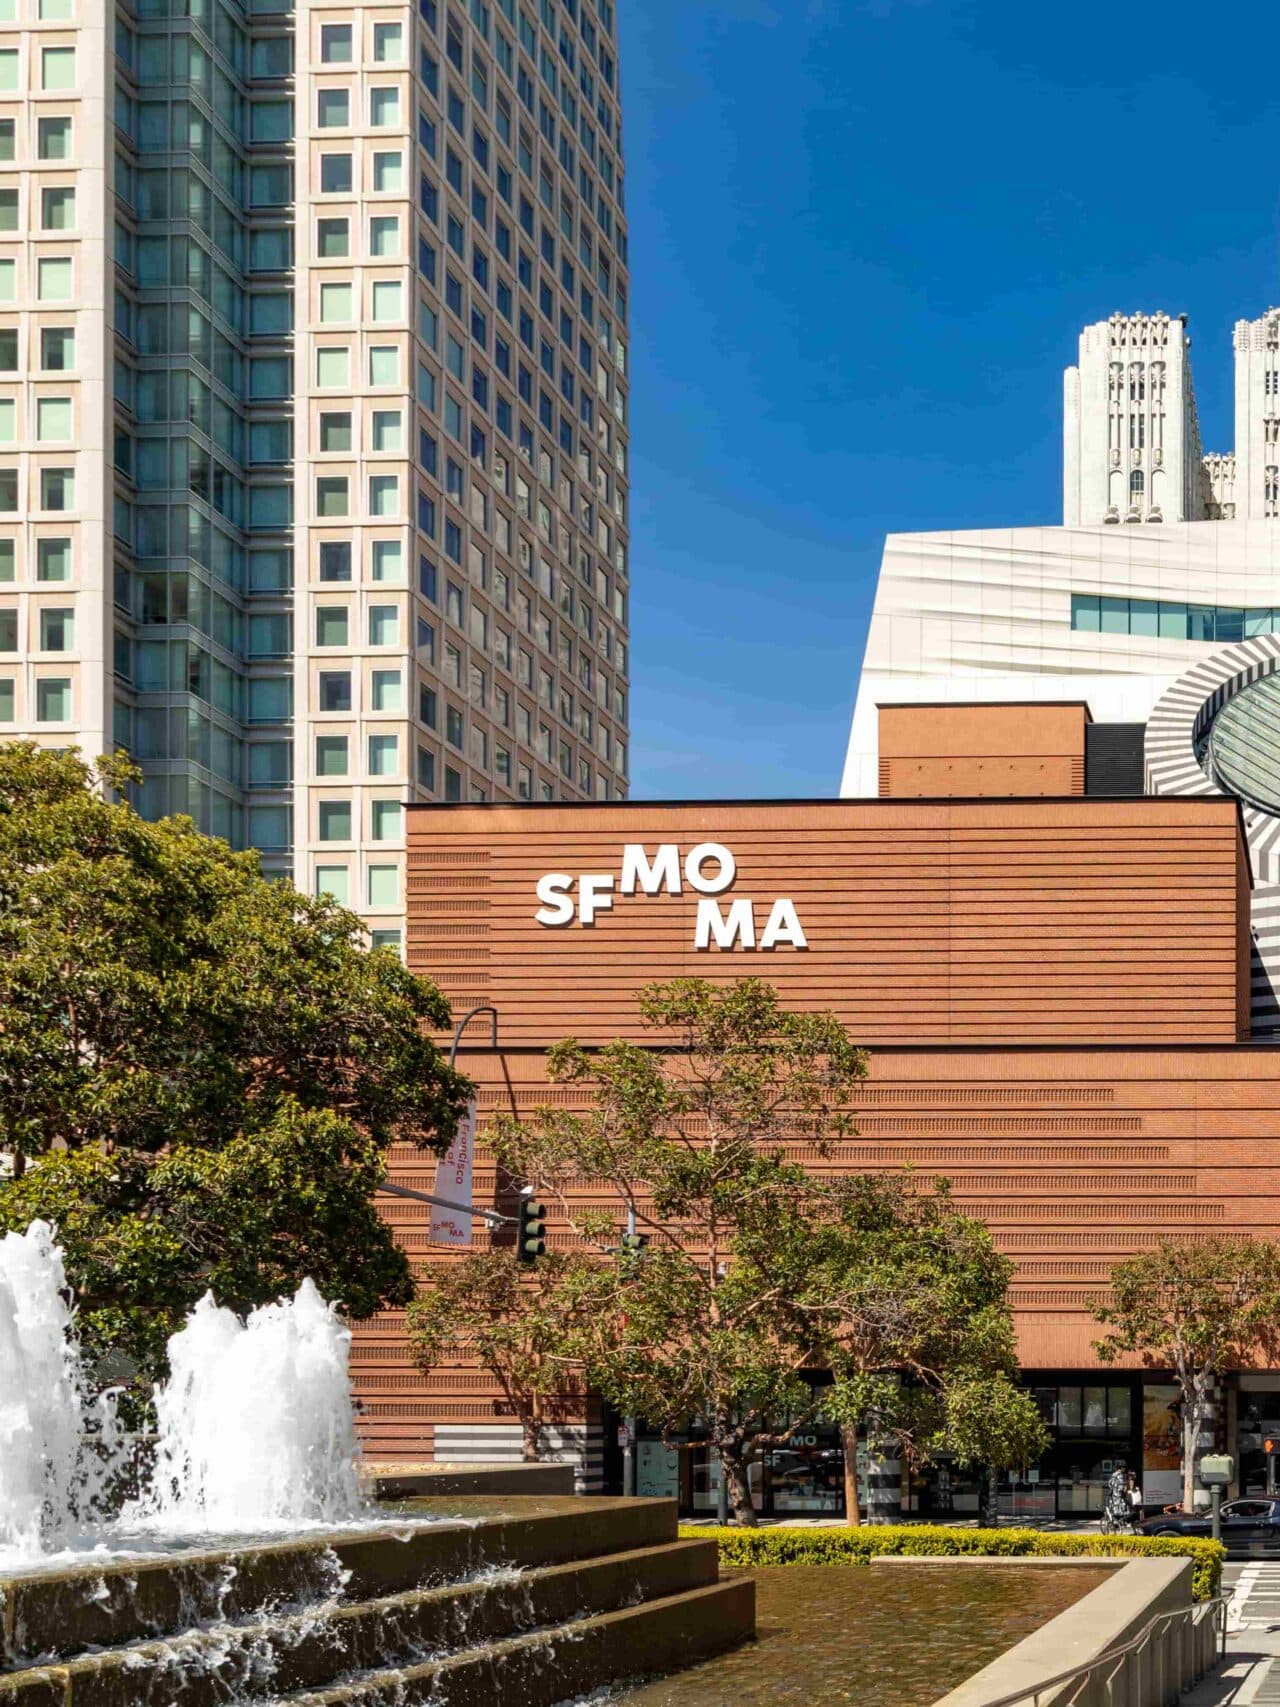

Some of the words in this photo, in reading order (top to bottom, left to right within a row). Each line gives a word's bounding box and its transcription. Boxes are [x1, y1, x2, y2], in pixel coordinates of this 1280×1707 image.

[620, 842, 736, 894] MO
[535, 873, 614, 926] SF
[695, 898, 808, 948] MA
[455, 1123, 470, 1185] Francisco
[433, 1223, 441, 1231] SF
[441, 1221, 455, 1229] MO
[449, 1229, 465, 1237] MA
[789, 1435, 817, 1447] MO
[763, 1454, 781, 1467] SF
